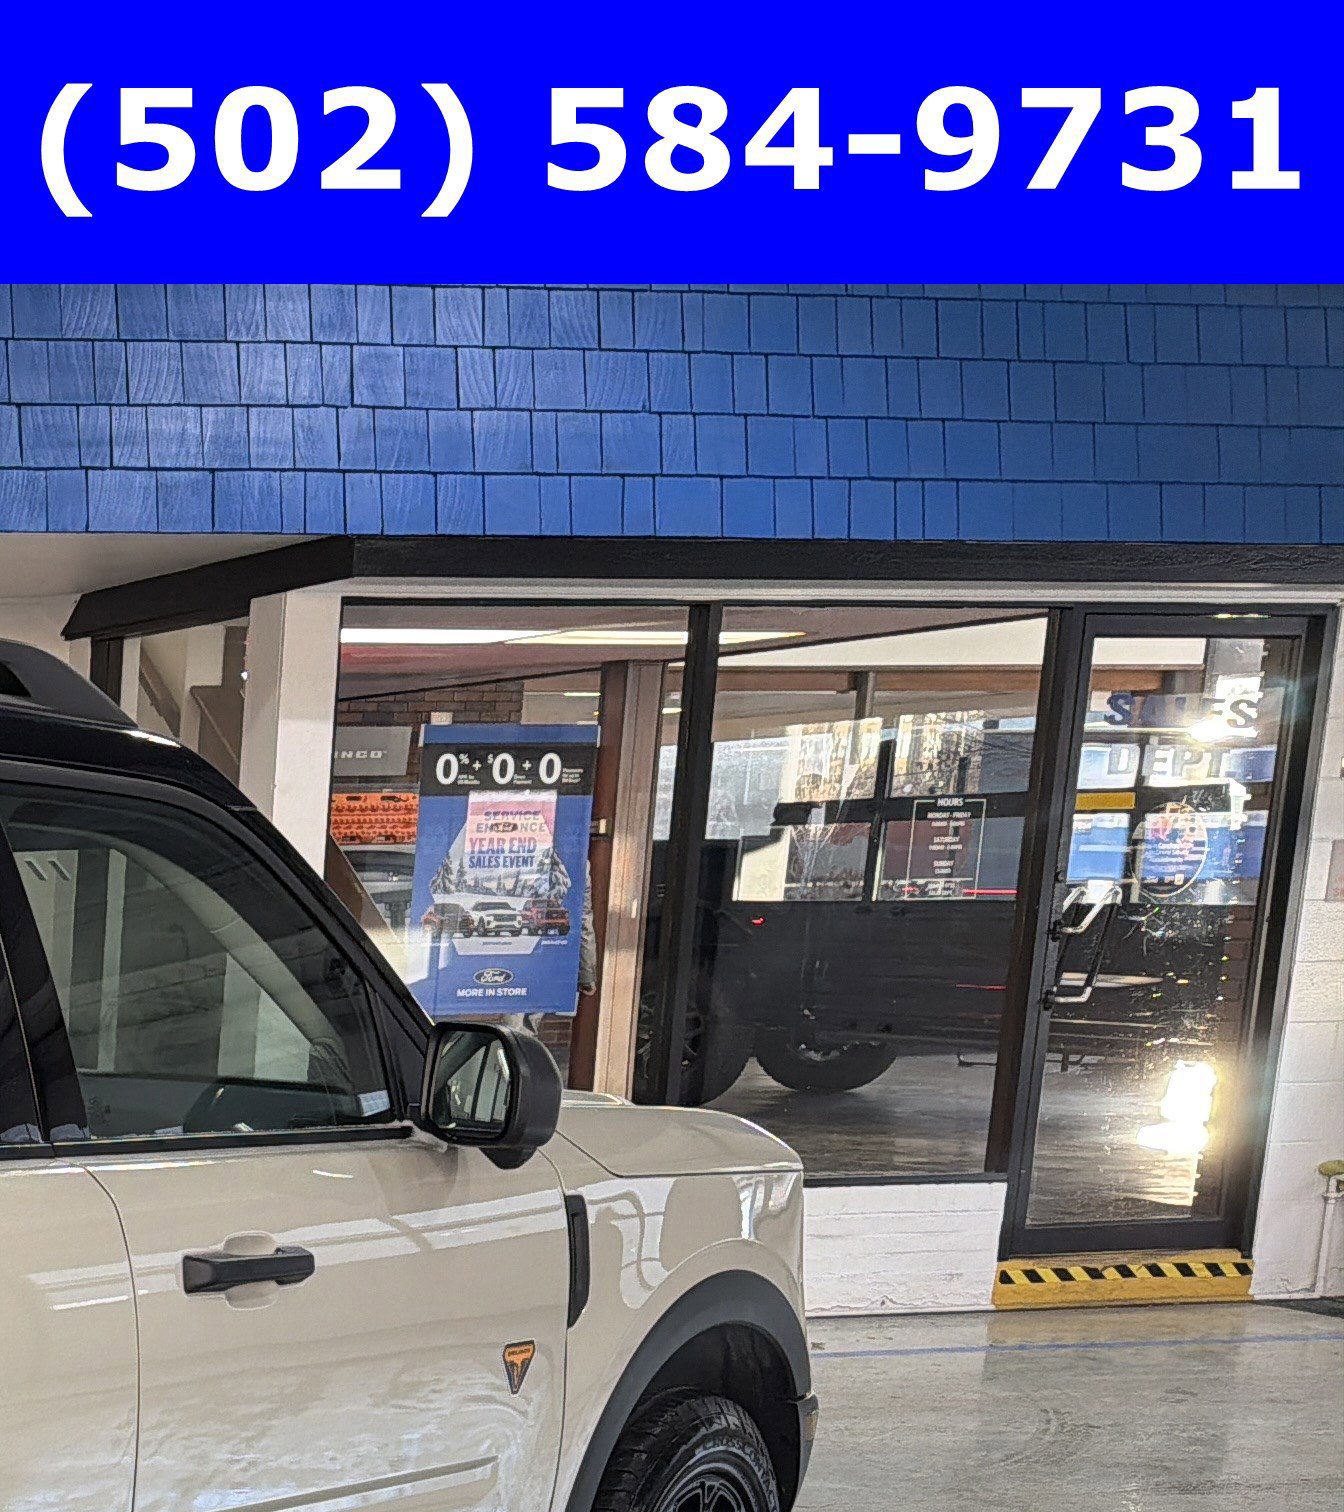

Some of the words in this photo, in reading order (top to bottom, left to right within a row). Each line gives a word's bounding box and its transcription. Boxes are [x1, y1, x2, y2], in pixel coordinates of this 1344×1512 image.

[538, 753, 562, 785] 0
[469, 838, 507, 854] YEAR
[508, 837, 537, 854] END
[468, 856, 500, 868] SALES
[502, 856, 536, 868] EVENT
[480, 970, 505, 983] Ford
[456, 989, 483, 997] MORE
[496, 988, 528, 996] STORE
